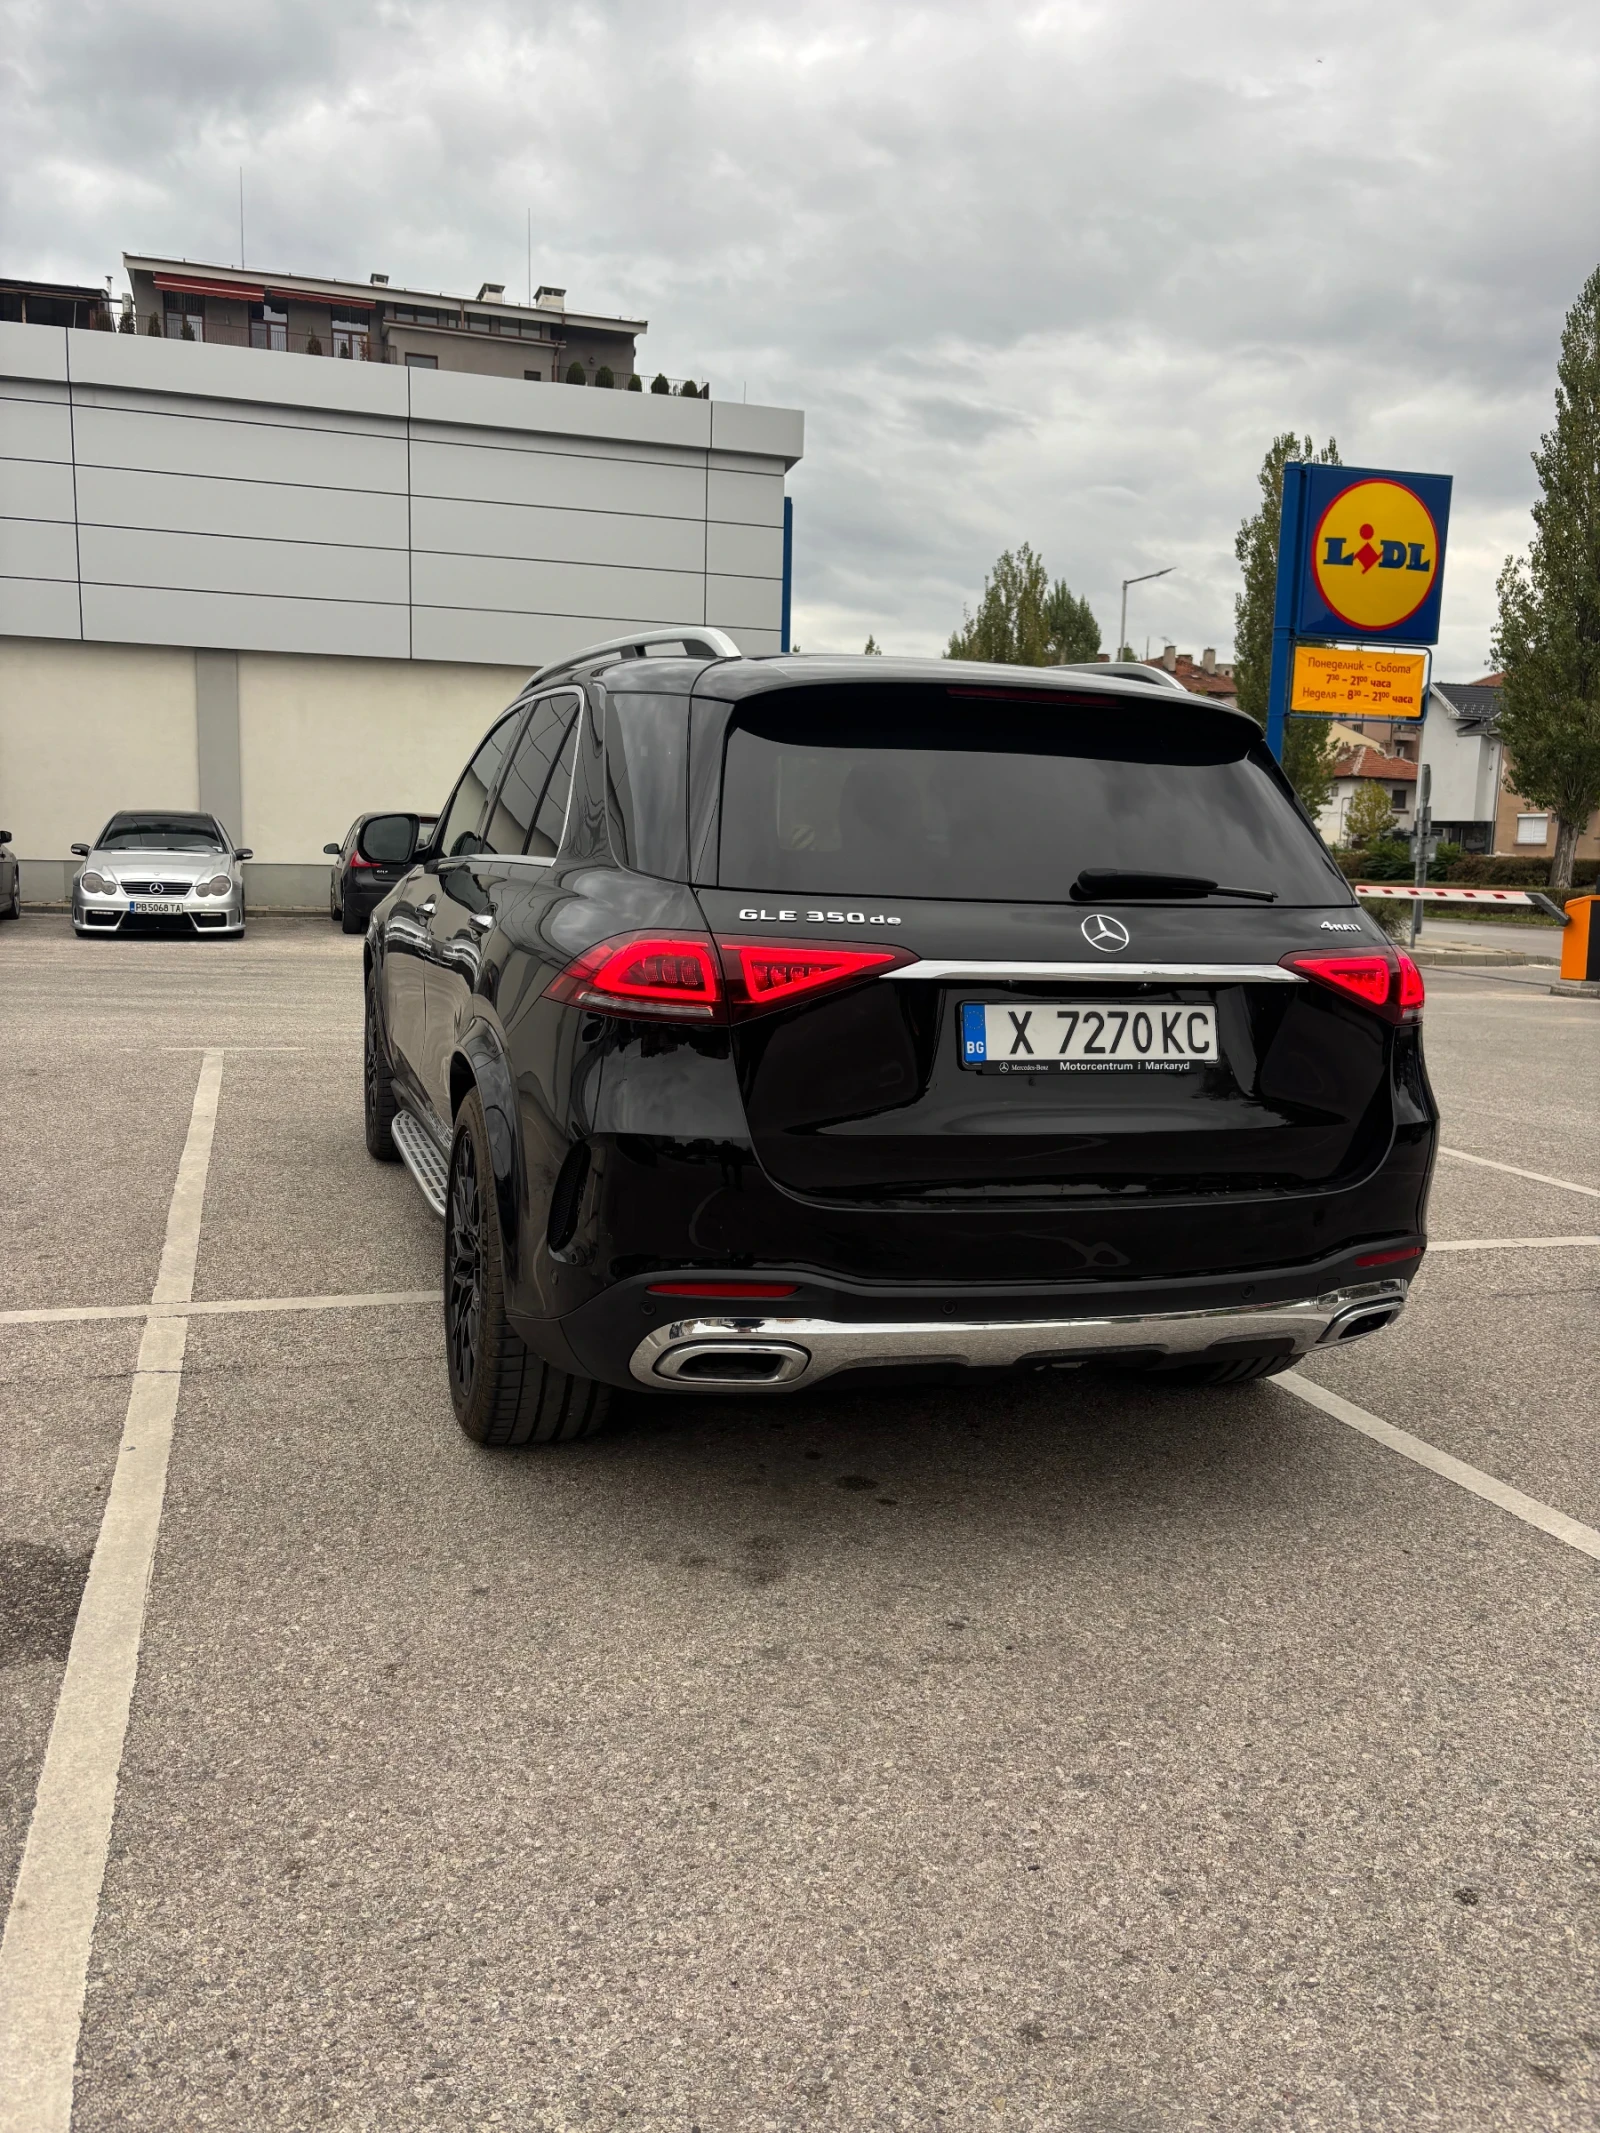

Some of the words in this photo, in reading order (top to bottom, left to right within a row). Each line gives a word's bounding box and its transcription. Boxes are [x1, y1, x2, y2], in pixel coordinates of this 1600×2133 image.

[1308, 657, 1364, 671] Понеделник
[1374, 661, 1411, 674] Събота
[1370, 680, 1391, 688] часа
[1302, 687, 1337, 701] Неделя
[1392, 695, 1413, 704] часа
[739, 908, 797, 921] GLE
[1008, 1010, 1034, 1055] X
[966, 1041, 984, 1054] BG
[1059, 1061, 1133, 1071] Motorcentrum
[1145, 1061, 1190, 1072] Markaryd
